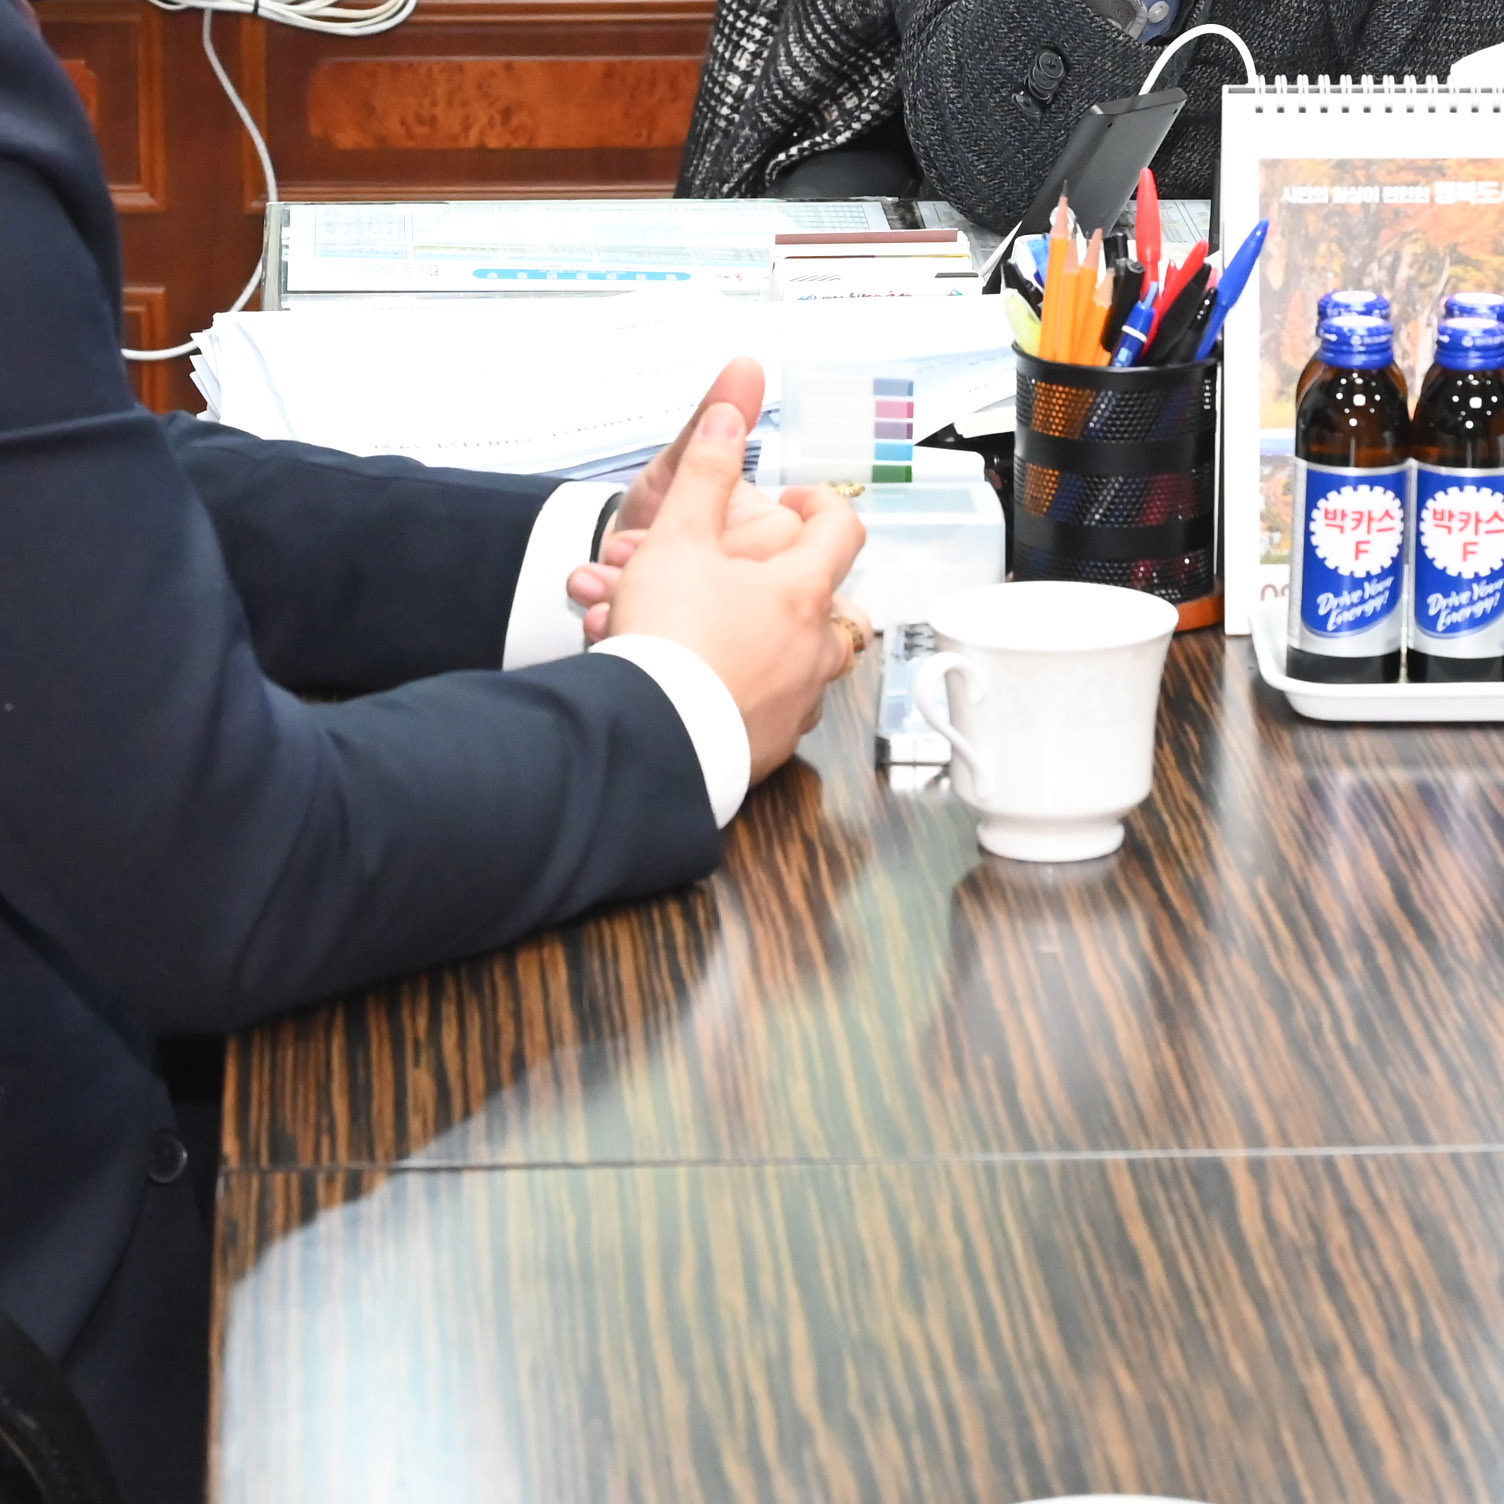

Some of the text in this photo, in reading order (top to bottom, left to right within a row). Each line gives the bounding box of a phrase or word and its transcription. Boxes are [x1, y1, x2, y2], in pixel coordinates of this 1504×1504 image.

[1324, 507, 1395, 534] 박카스
[1354, 541, 1371, 561] F
[1462, 542, 1479, 562] F
[1316, 589, 1363, 616] Drive
[1363, 576, 1394, 599] Your
[1427, 590, 1472, 617] Drive
[1327, 591, 1390, 632] Energy!
[1437, 592, 1501, 633] Energy!
